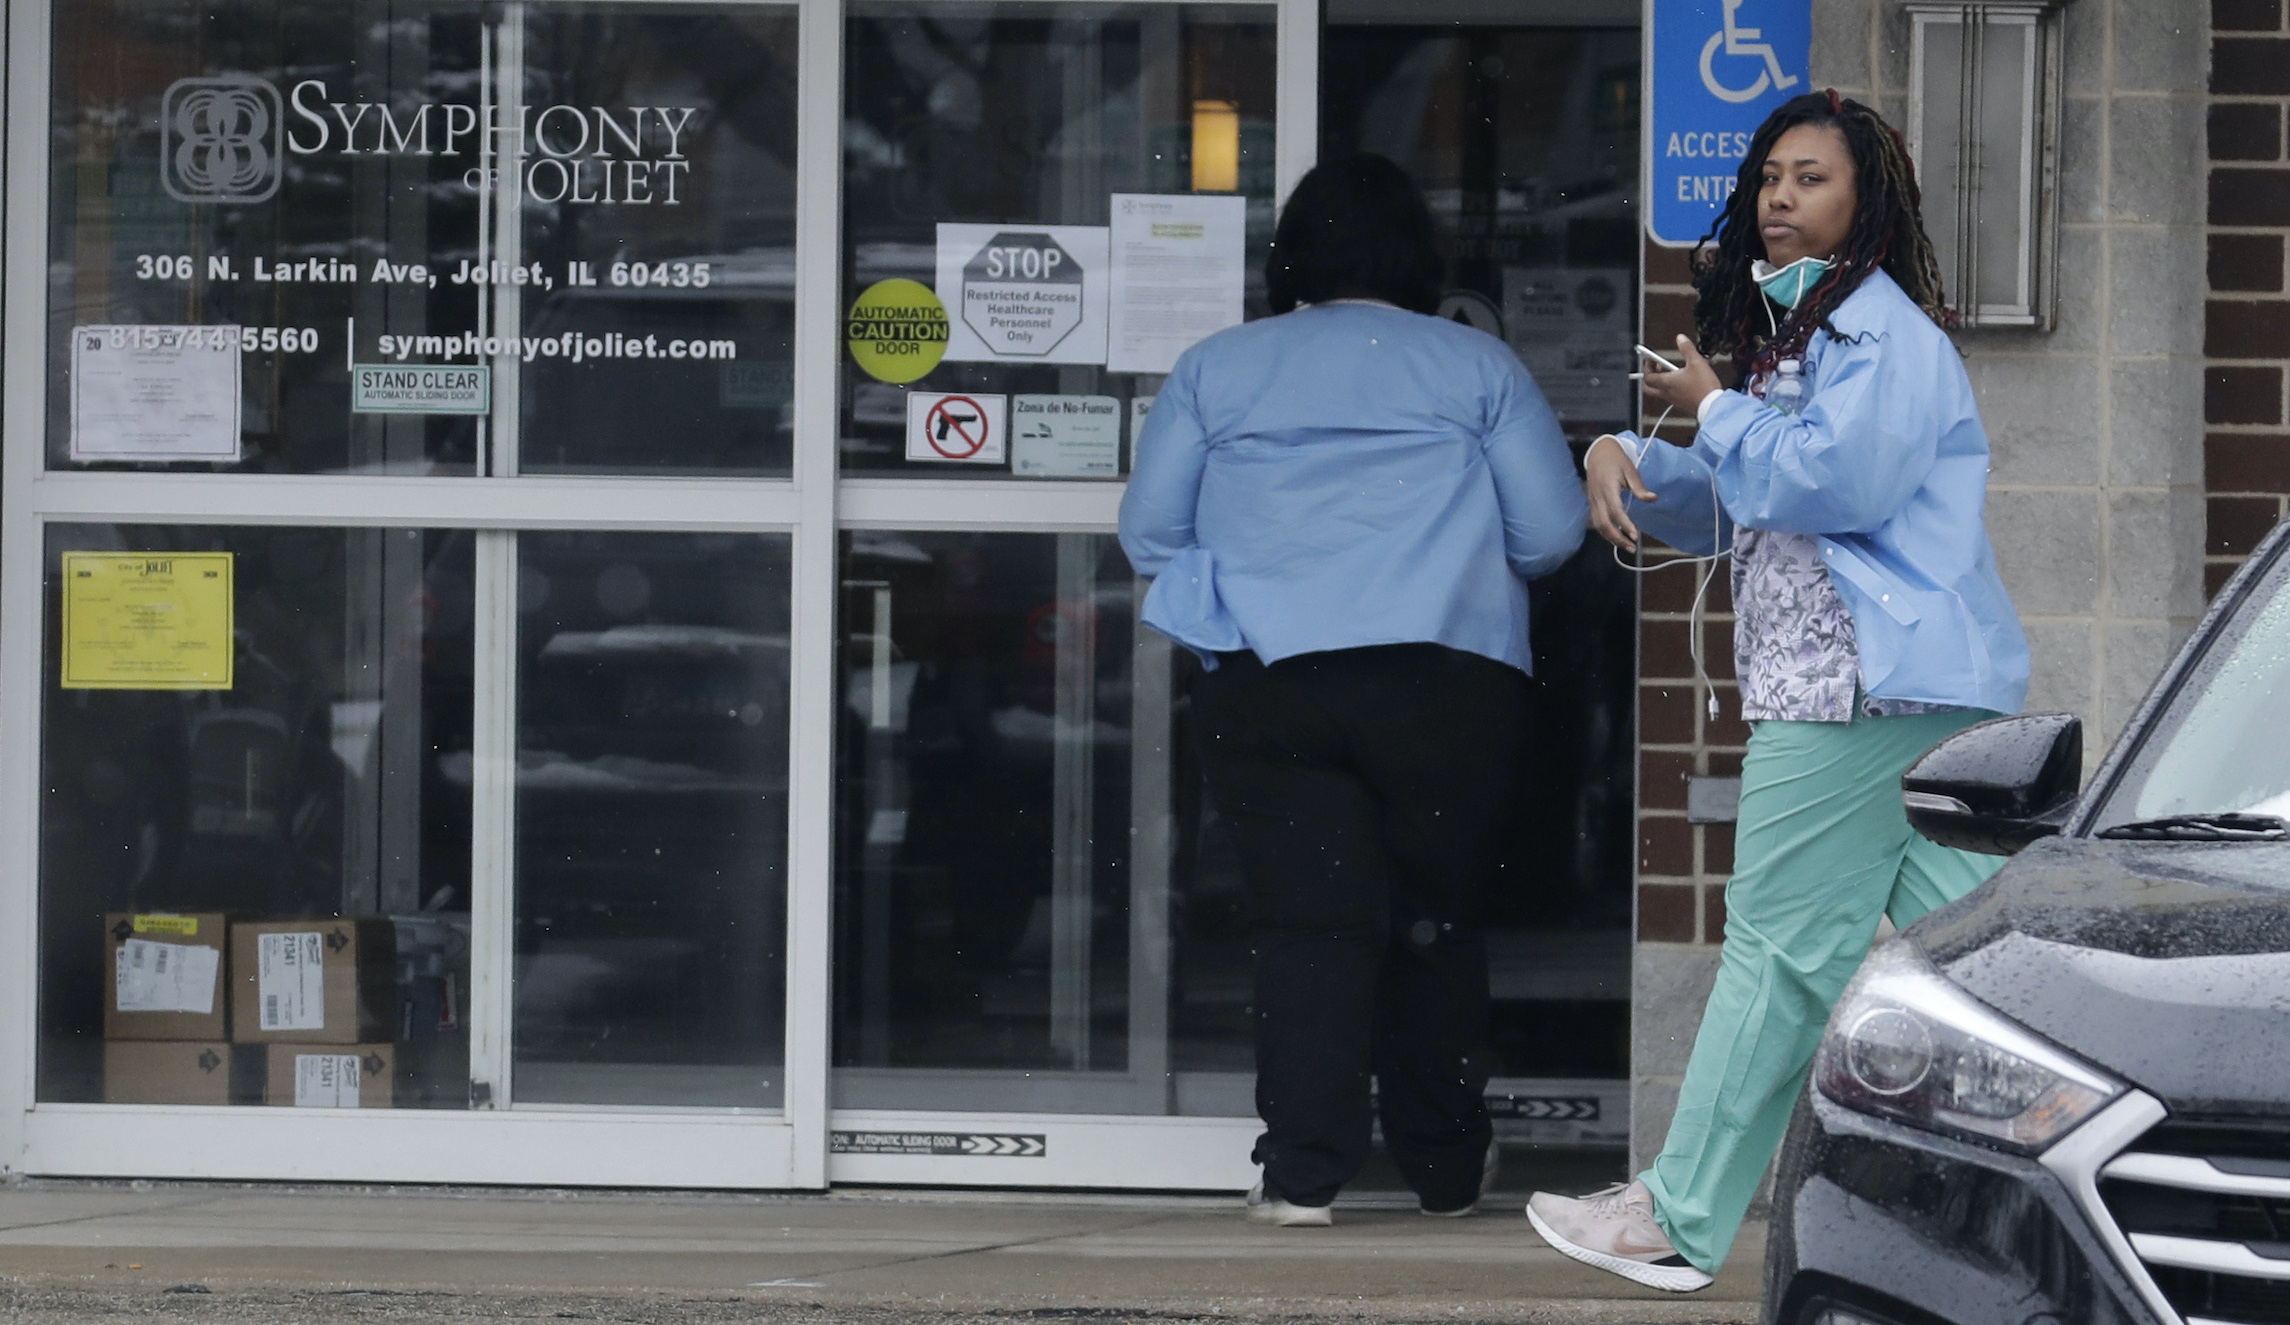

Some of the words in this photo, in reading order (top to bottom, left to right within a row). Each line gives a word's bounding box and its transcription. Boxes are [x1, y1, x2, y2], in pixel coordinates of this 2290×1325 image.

[287, 79, 696, 159] SYMPHONY
[1666, 131, 1755, 158] ACCES
[512, 158, 690, 208] JOLIET
[986, 246, 1062, 279] STOP
[135, 254, 194, 281] 306
[207, 255, 240, 281] N.
[253, 256, 358, 283] Larkin
[370, 257, 438, 289] Ave,
[450, 259, 553, 291] Joliet,
[567, 260, 598, 287] IL
[610, 261, 712, 288] 60435
[966, 288, 1031, 301] Restricted
[1033, 290, 1078, 303] Access
[853, 306, 944, 319] AUTOMATIC
[987, 302, 1055, 316] Healthcare
[848, 322, 948, 341] CAUTION
[990, 316, 1052, 329] Personnel
[109, 325, 320, 353] 815-744-5560
[377, 330, 737, 363] symphonyofjoliet.com
[1006, 330, 1034, 345] Only
[875, 342, 920, 355] DOOR
[362, 371, 418, 389] STAND
[422, 372, 479, 390] CLEAR
[364, 389, 414, 400] AUTOMATIC
[415, 390, 450, 401] SLIDING
[450, 391, 476, 401] DOOR
[1016, 401, 1045, 413] Zona
[1046, 401, 1061, 413] de
[1062, 402, 1114, 414] No-Fumar
[283, 935, 296, 966] 21341
[321, 1056, 333, 1088] 21341
[854, 1133, 901, 1146] AUTOMATIC
[932, 1135, 958, 1148] DOOR
